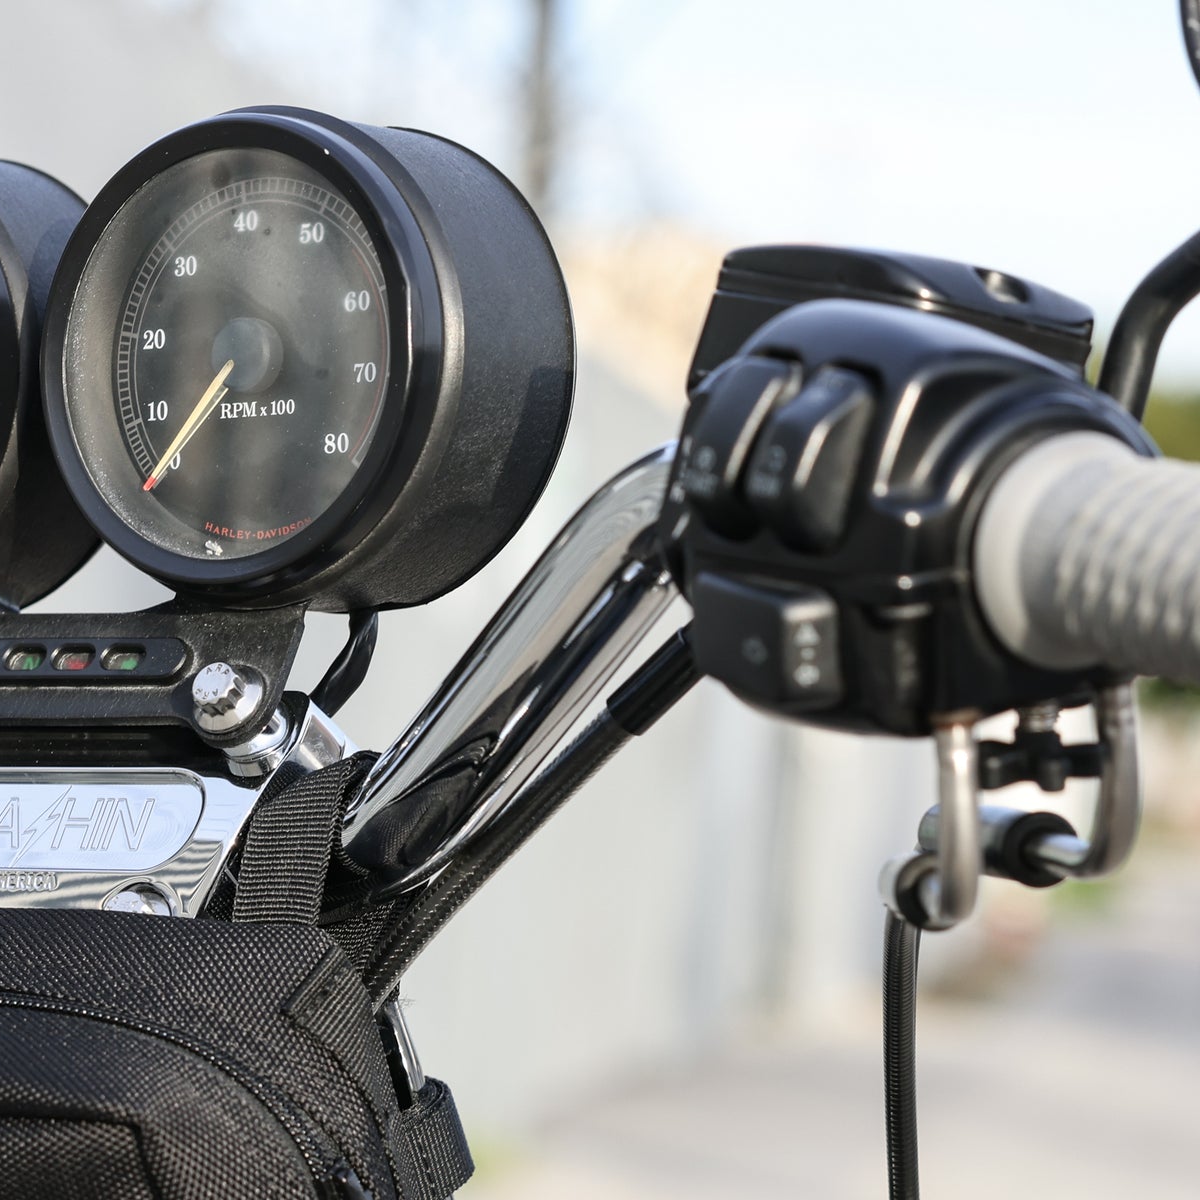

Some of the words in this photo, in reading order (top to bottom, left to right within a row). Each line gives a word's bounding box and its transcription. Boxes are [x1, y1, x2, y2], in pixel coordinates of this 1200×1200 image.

[233, 211, 258, 231] 40
[299, 223, 324, 244] 50
[174, 256, 197, 277] 30
[344, 291, 370, 312] 60
[143, 329, 166, 350] 20
[353, 362, 377, 384] 70
[147, 400, 168, 422] 10
[220, 401, 257, 420] RPM
[259, 406, 267, 417] x
[270, 398, 295, 416] 100
[324, 432, 349, 454] 80
[168, 450, 181, 470] 0
[204, 517, 312, 540] HARLEY-DAVIDSON
